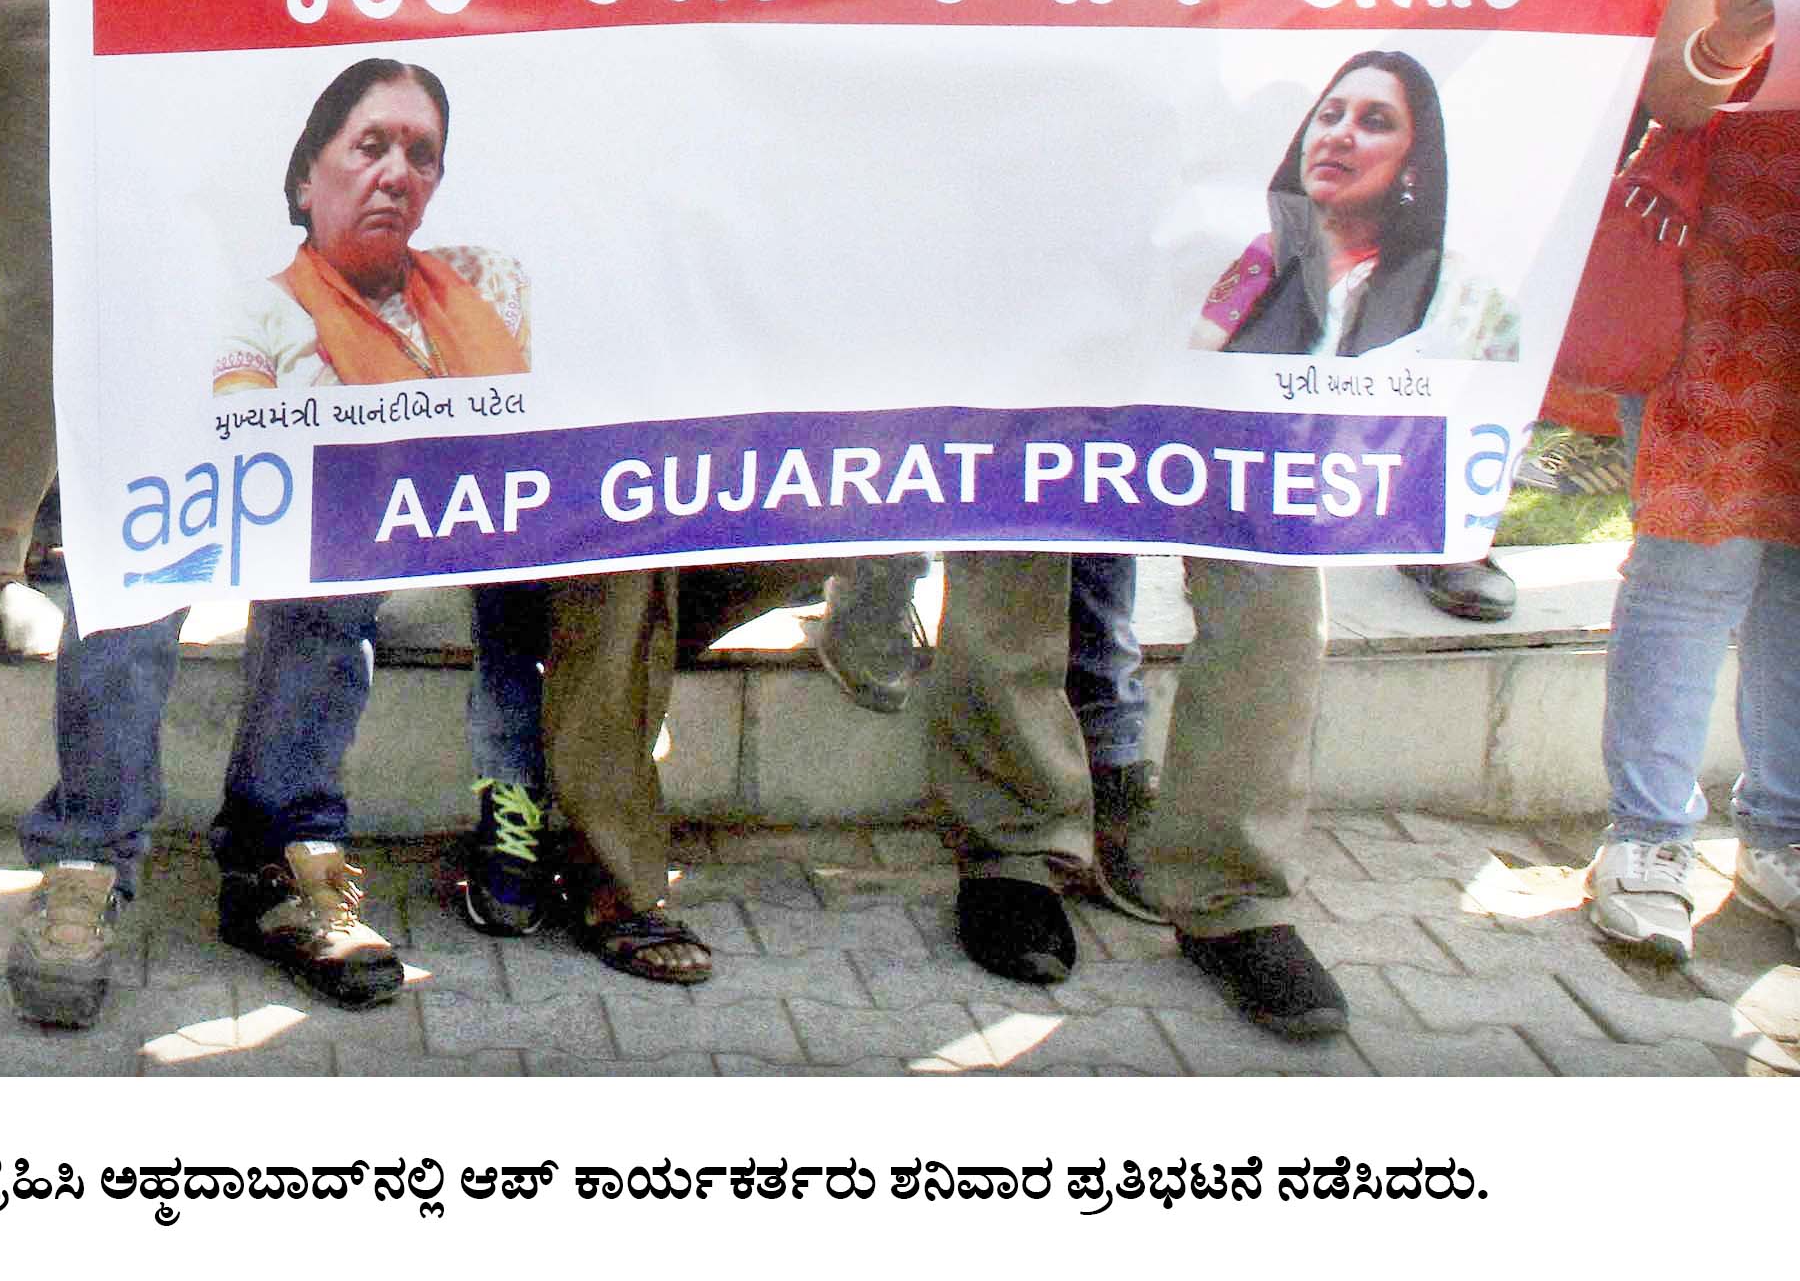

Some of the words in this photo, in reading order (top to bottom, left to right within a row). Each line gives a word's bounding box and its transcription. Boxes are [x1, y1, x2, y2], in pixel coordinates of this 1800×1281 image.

[1387, 368, 1432, 398] પટેલ
[332, 391, 457, 427] આનંદીબેન
[467, 391, 528, 418] પટેલ
[122, 450, 295, 587] aap
[372, 469, 552, 544] AAP
[599, 441, 994, 523] GUJARAT
[1023, 441, 1402, 519] PROTEST
